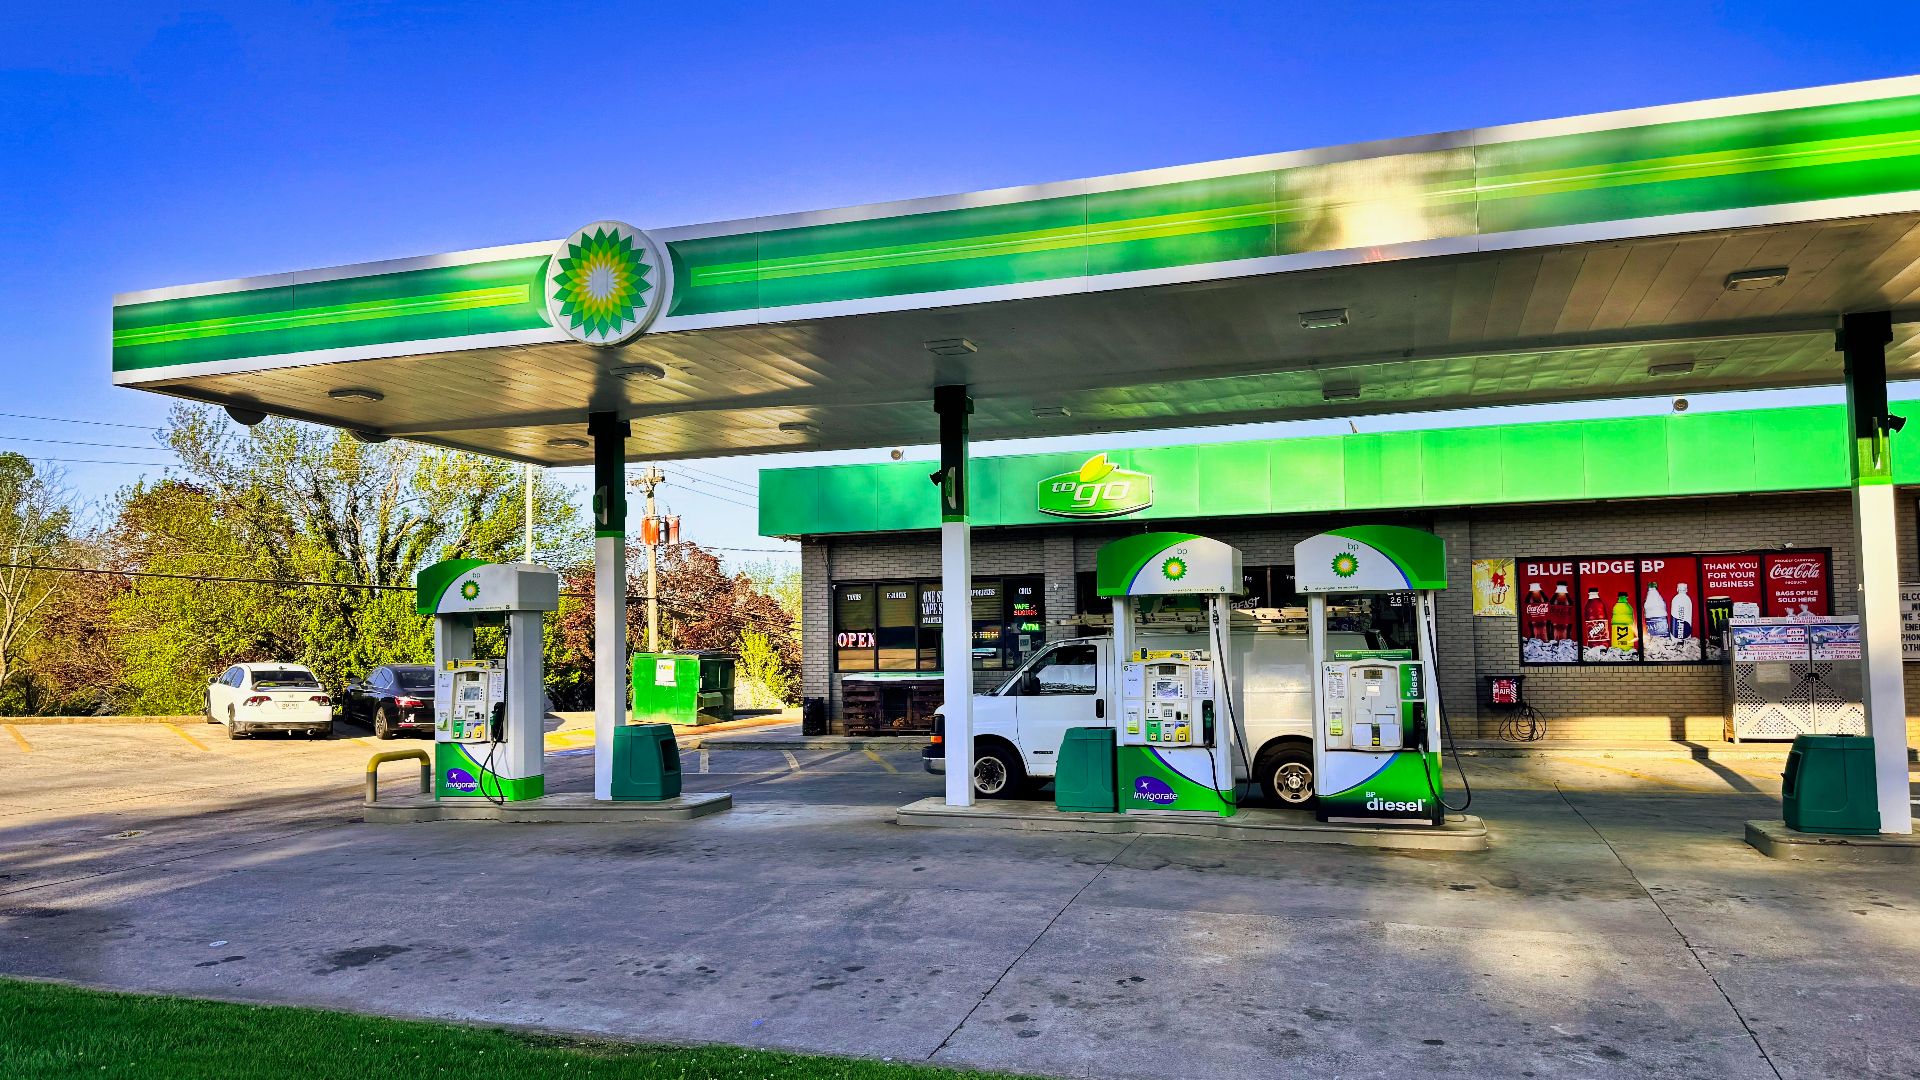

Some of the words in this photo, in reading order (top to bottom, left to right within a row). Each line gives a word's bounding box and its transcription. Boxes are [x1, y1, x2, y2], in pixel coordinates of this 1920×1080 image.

[1052, 482, 1077, 492] to
[1070, 481, 1130, 508] go
[1347, 542, 1359, 551] bp
[1527, 563, 1573, 576] BLUE
[1579, 561, 1635, 574] RIDGE
[1641, 560, 1665, 573] BP
[1704, 562, 1736, 570] THANK
[1738, 562, 1758, 570] YOU
[1770, 562, 1821, 579] Coca-Cola
[1709, 580, 1754, 588] BUSINESS
[923, 591, 935, 602] ONE
[922, 603, 938, 615] VAPE
[1021, 622, 1039, 630] ATM
[837, 632, 875, 647] OPEN
[1409, 667, 1418, 697] diesel
[1366, 798, 1422, 812] diesel
